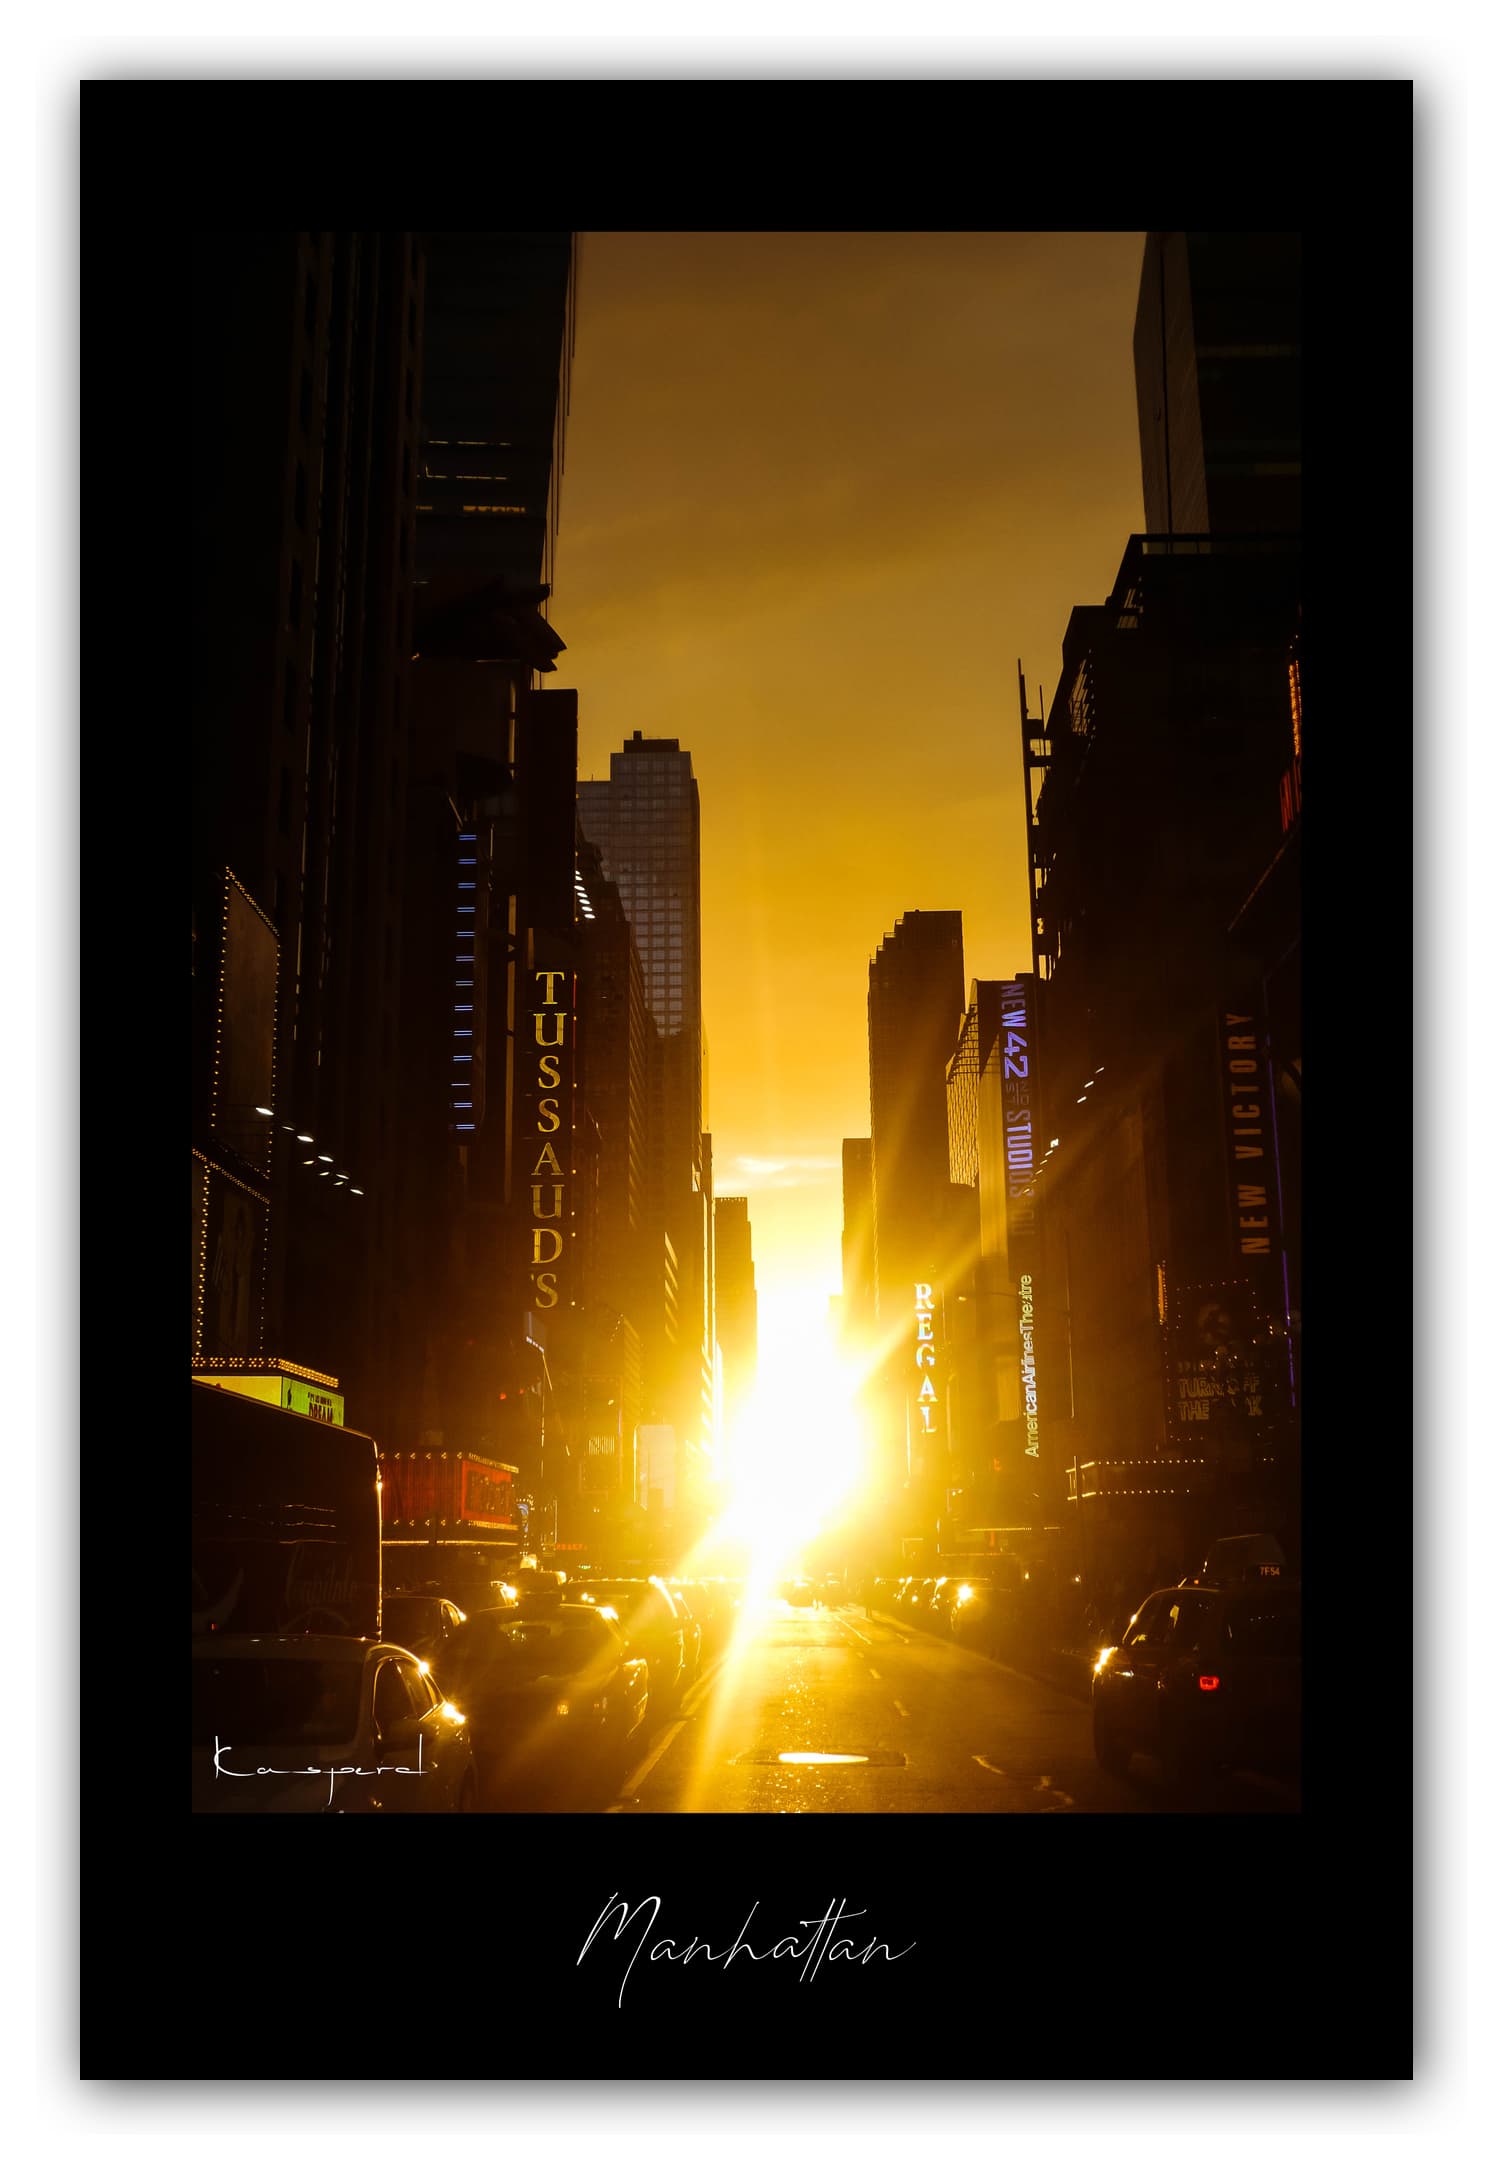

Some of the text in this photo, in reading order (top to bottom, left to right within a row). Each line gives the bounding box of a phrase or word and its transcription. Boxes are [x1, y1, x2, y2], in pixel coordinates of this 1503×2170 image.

[1001, 982, 1027, 1028] NEW
[530, 971, 567, 1310] TUSSAUD'S
[1006, 1108, 1034, 1200] STUDIOS
[1225, 1013, 1271, 1255] NEW VICTORY
[914, 1283, 938, 1433] REGAL
[1179, 1399, 1209, 1421] THE
